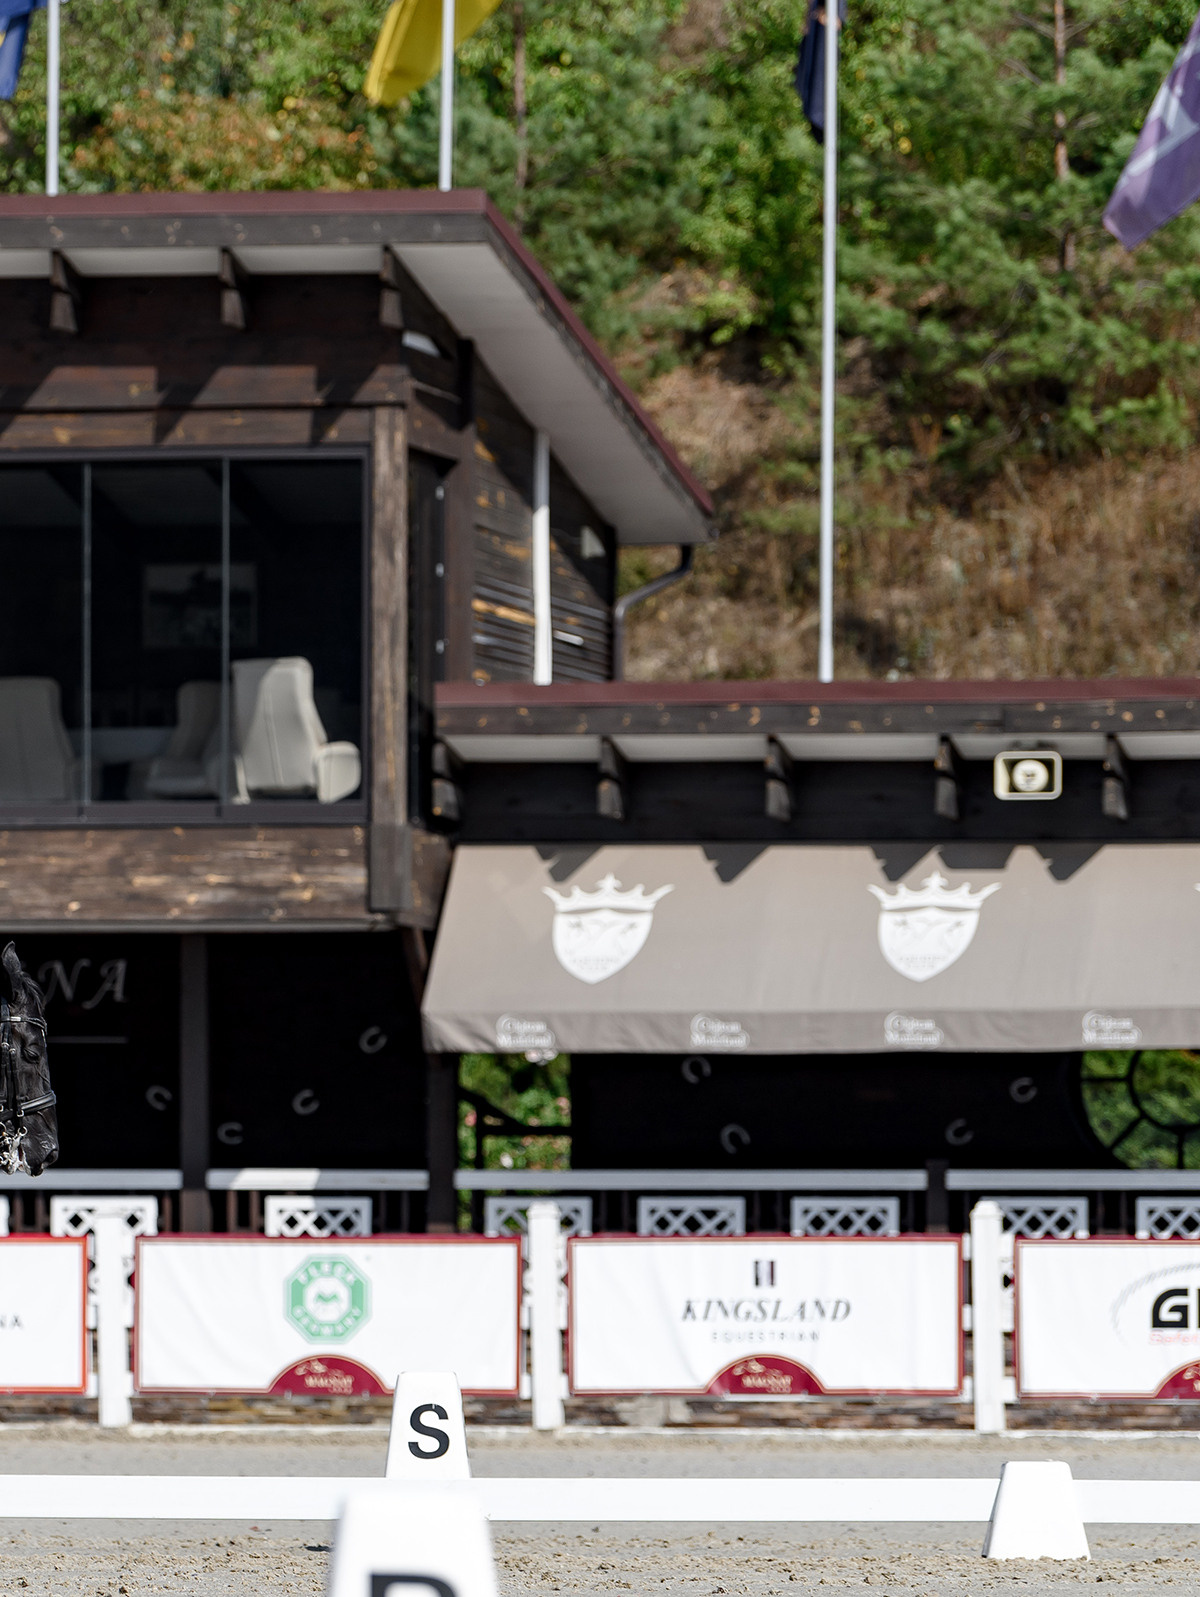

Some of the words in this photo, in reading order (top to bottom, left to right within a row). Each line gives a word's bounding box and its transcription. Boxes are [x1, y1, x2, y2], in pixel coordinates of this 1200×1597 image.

[678, 1298, 852, 1322] KINGSLAND
[1151, 1287, 1200, 1329] G
[407, 1403, 450, 1460] S
